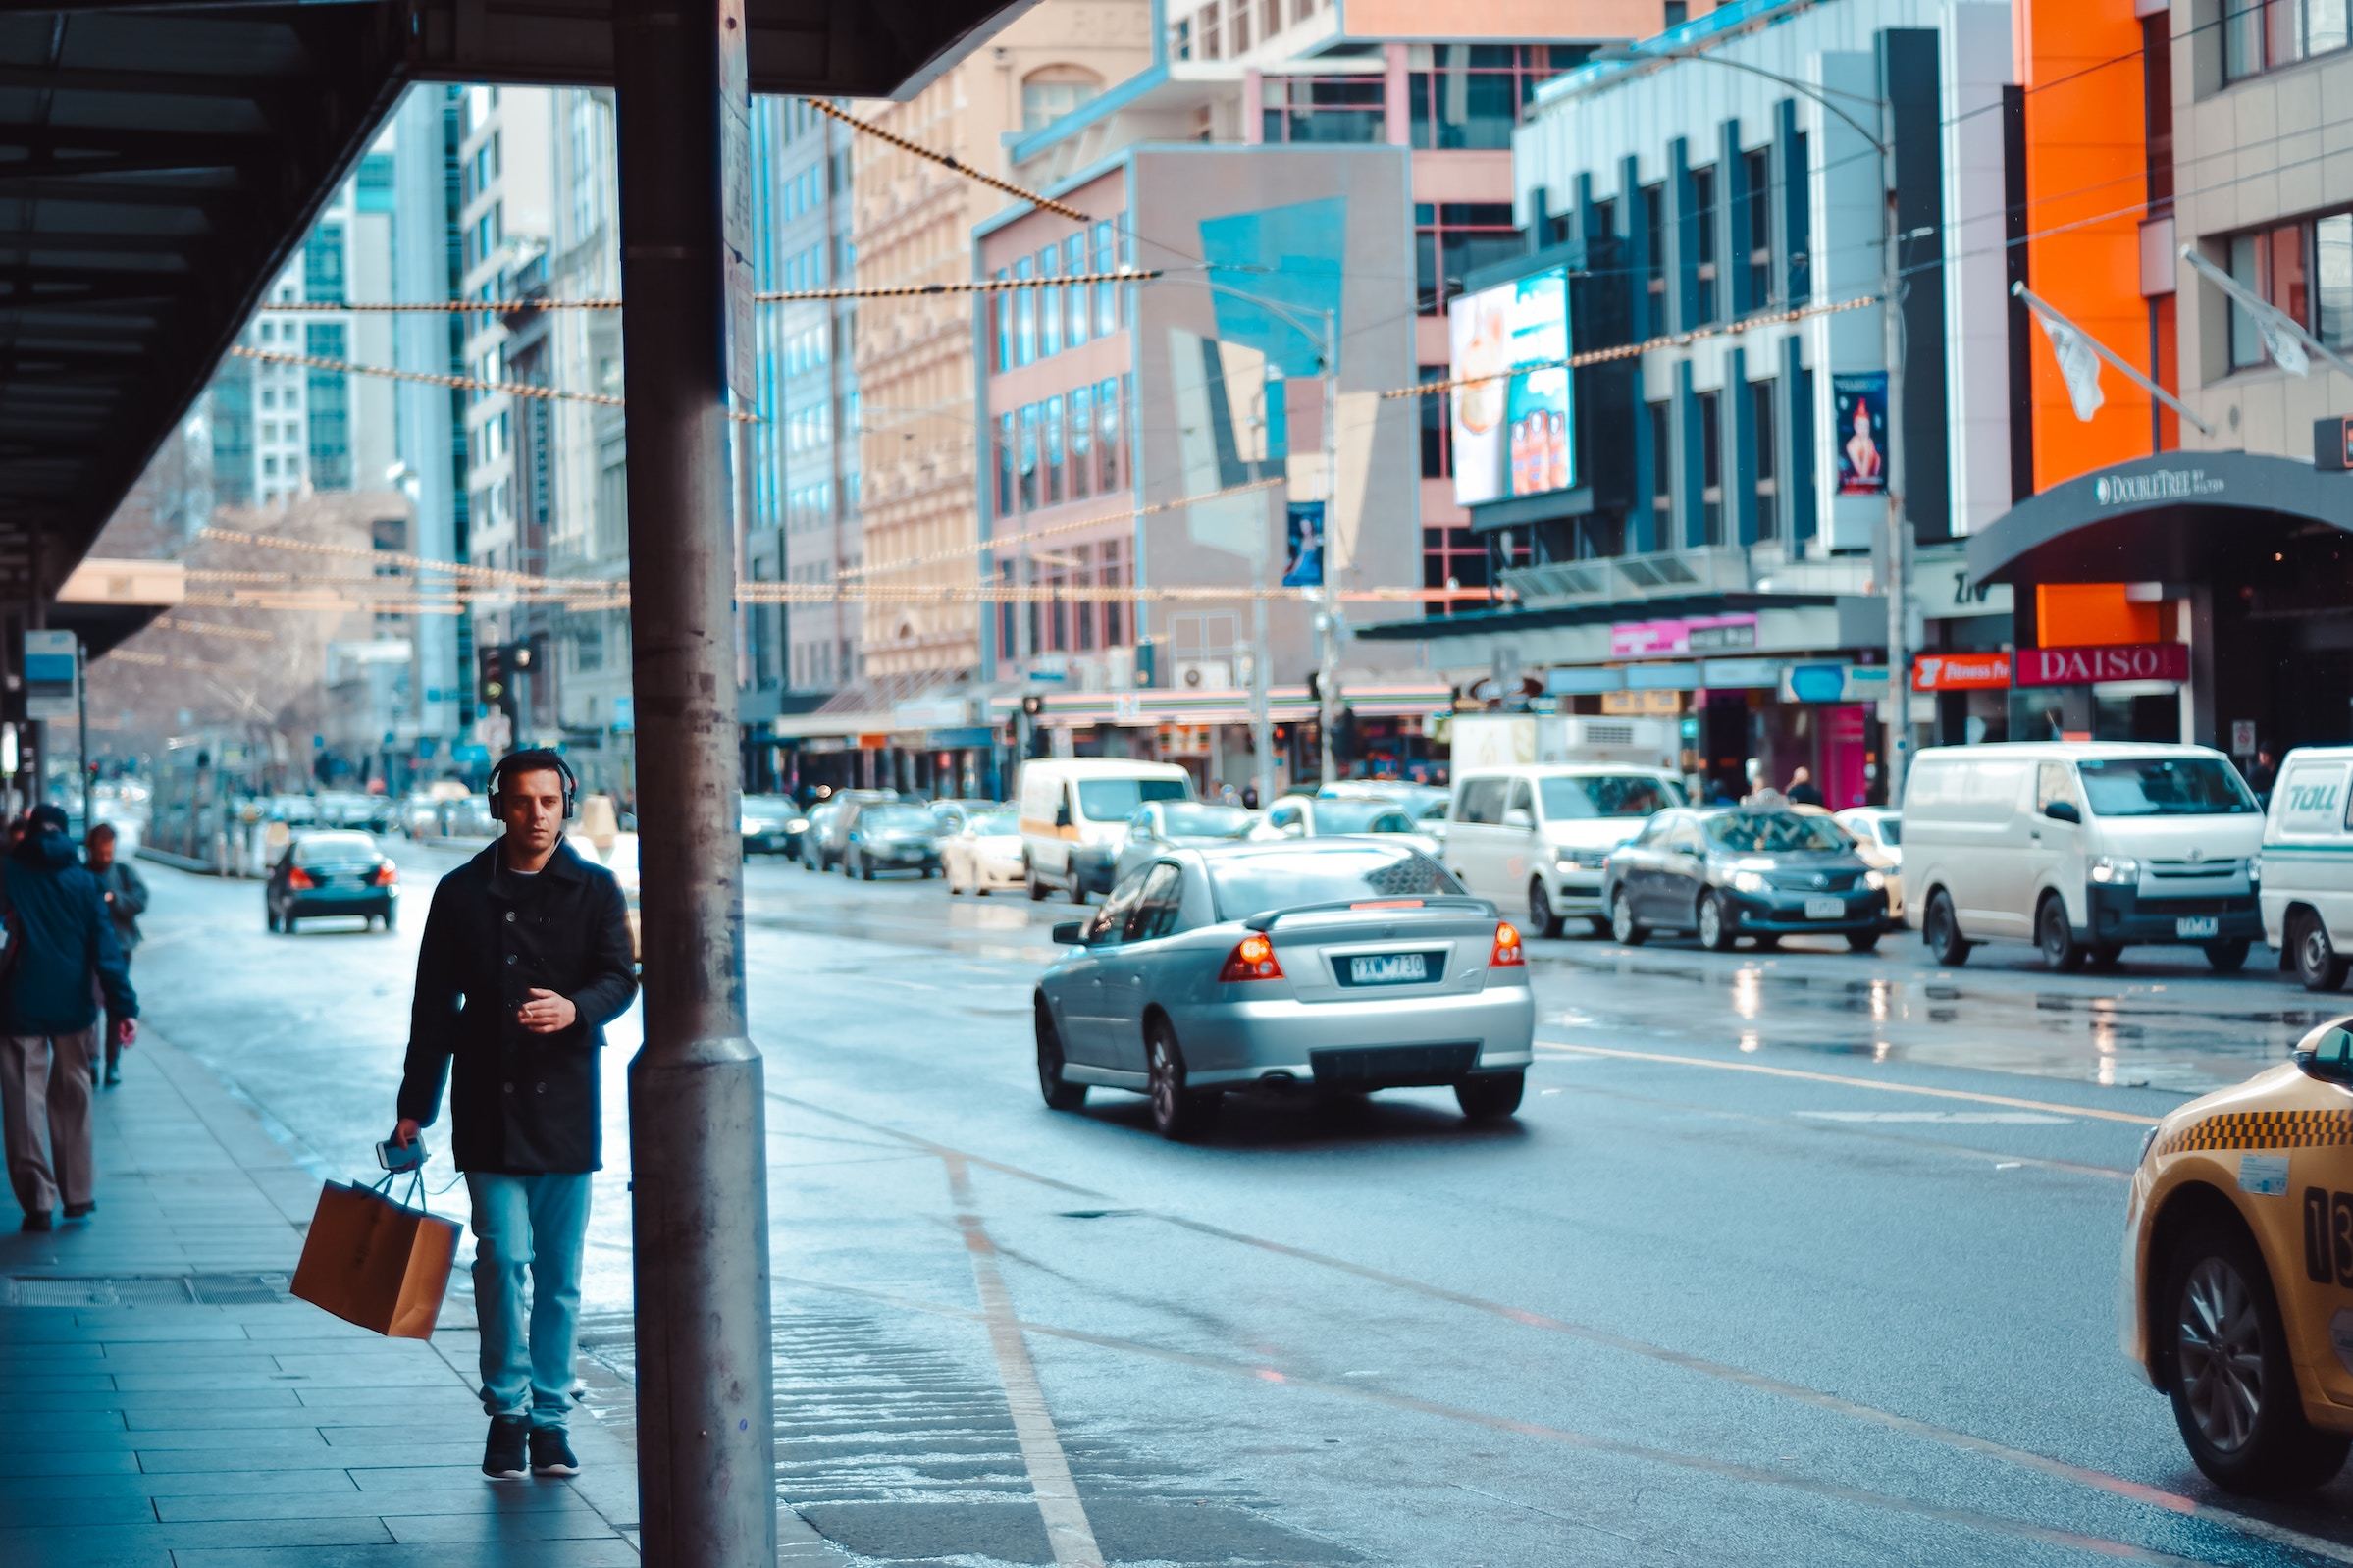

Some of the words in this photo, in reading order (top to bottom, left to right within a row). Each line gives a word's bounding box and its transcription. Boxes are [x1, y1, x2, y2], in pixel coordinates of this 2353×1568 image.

[1993, 660, 2011, 680] Fir
[2041, 649, 2158, 680] DAISO
[2291, 785, 2336, 811] TOLL
